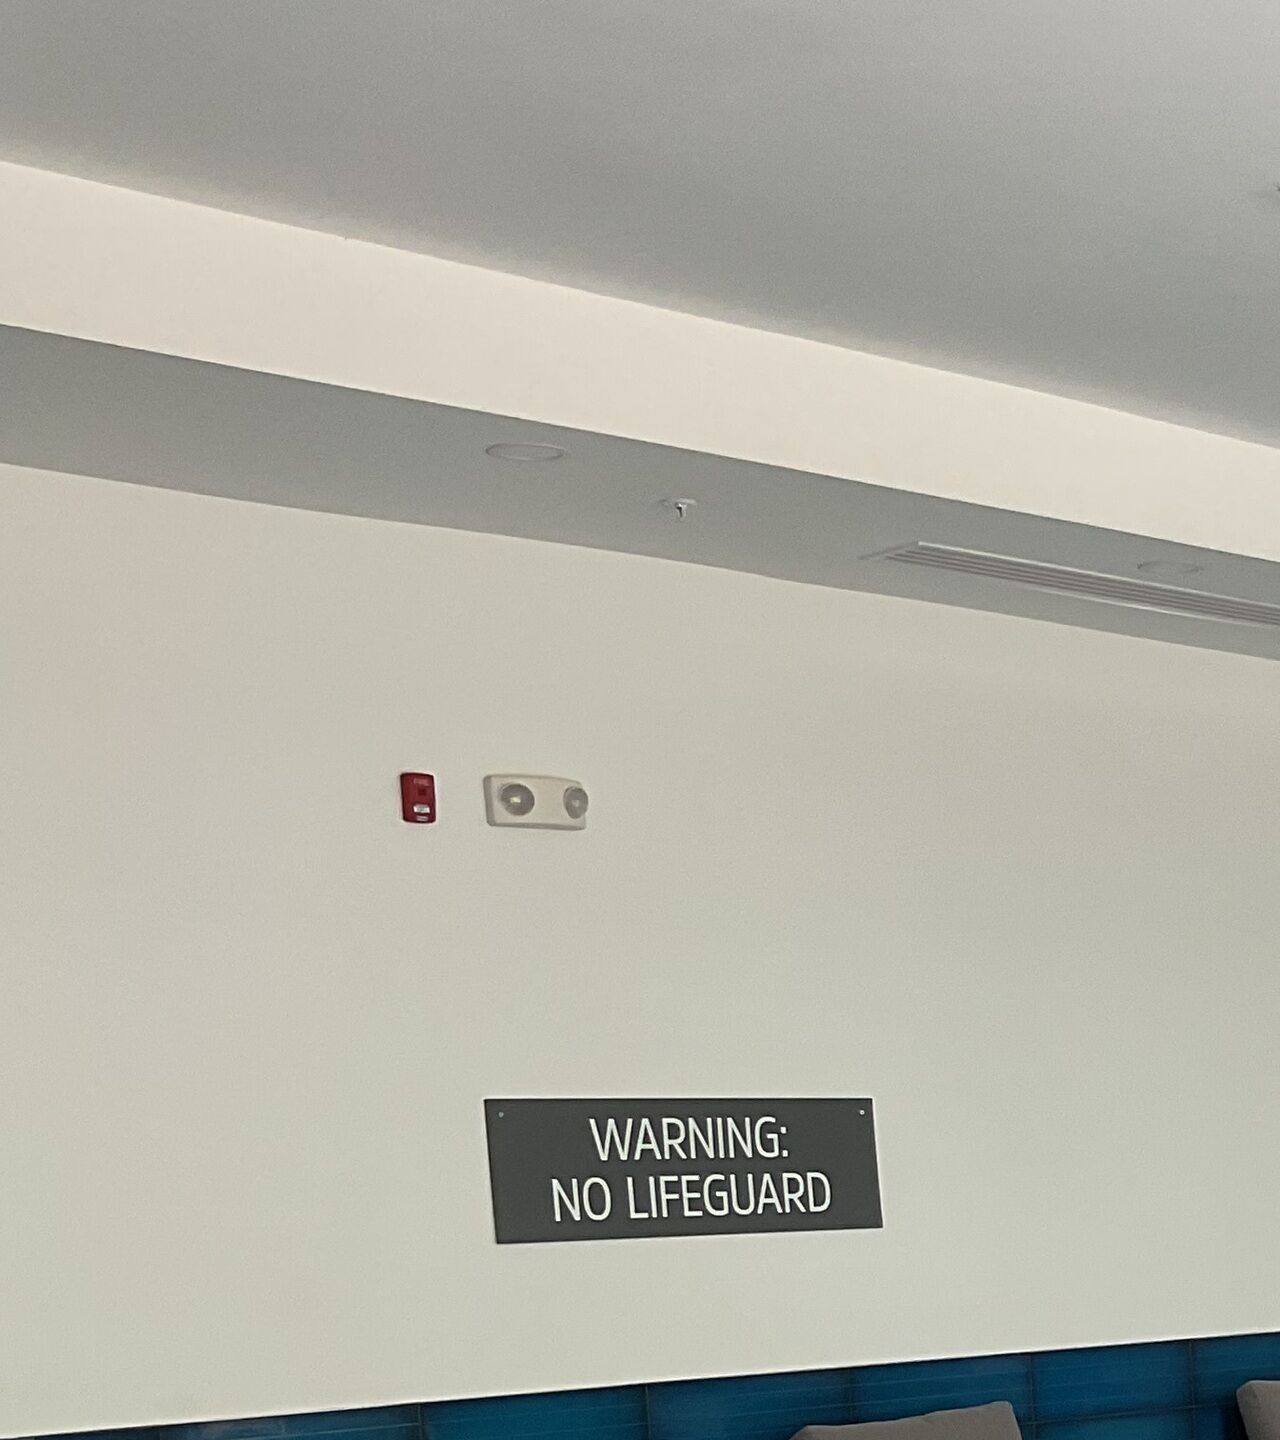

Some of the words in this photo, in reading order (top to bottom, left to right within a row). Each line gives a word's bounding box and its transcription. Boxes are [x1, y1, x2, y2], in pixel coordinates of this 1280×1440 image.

[588, 1116, 790, 1161] WARNING:
[550, 1176, 612, 1222] NO
[626, 1171, 832, 1220] LIFEGUARD
